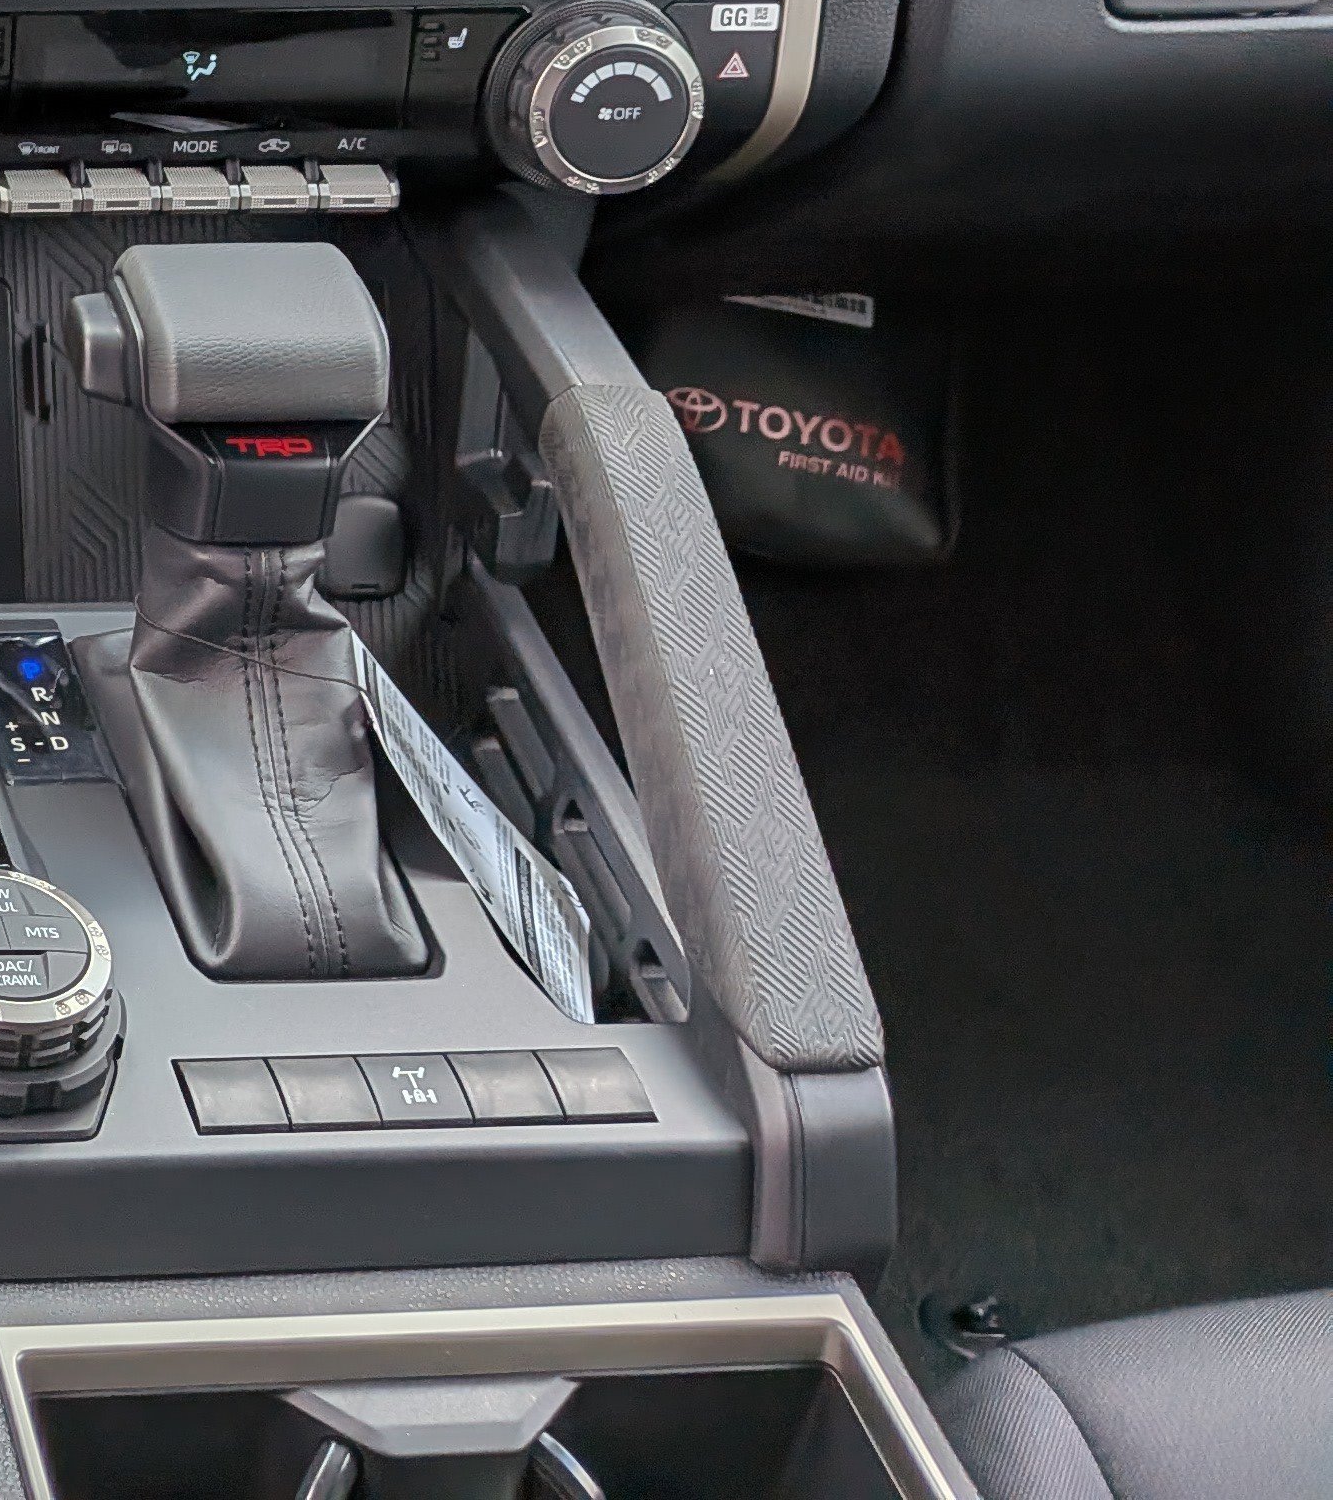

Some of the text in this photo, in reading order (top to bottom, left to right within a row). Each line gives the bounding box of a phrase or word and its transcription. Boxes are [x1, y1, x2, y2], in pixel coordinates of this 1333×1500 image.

[720, 8, 747, 26] GG
[614, 106, 641, 120] OFF
[172, 140, 218, 153] MODE
[338, 137, 366, 152] A/C
[733, 400, 905, 466] TOYOTA
[226, 436, 313, 458] TRD
[778, 450, 832, 475] FIRST
[836, 463, 868, 483] AID
[31, 687, 52, 702] R
[41, 712, 61, 726] N
[11, 736, 69, 751] S D
[25, 927, 60, 939] MTS
